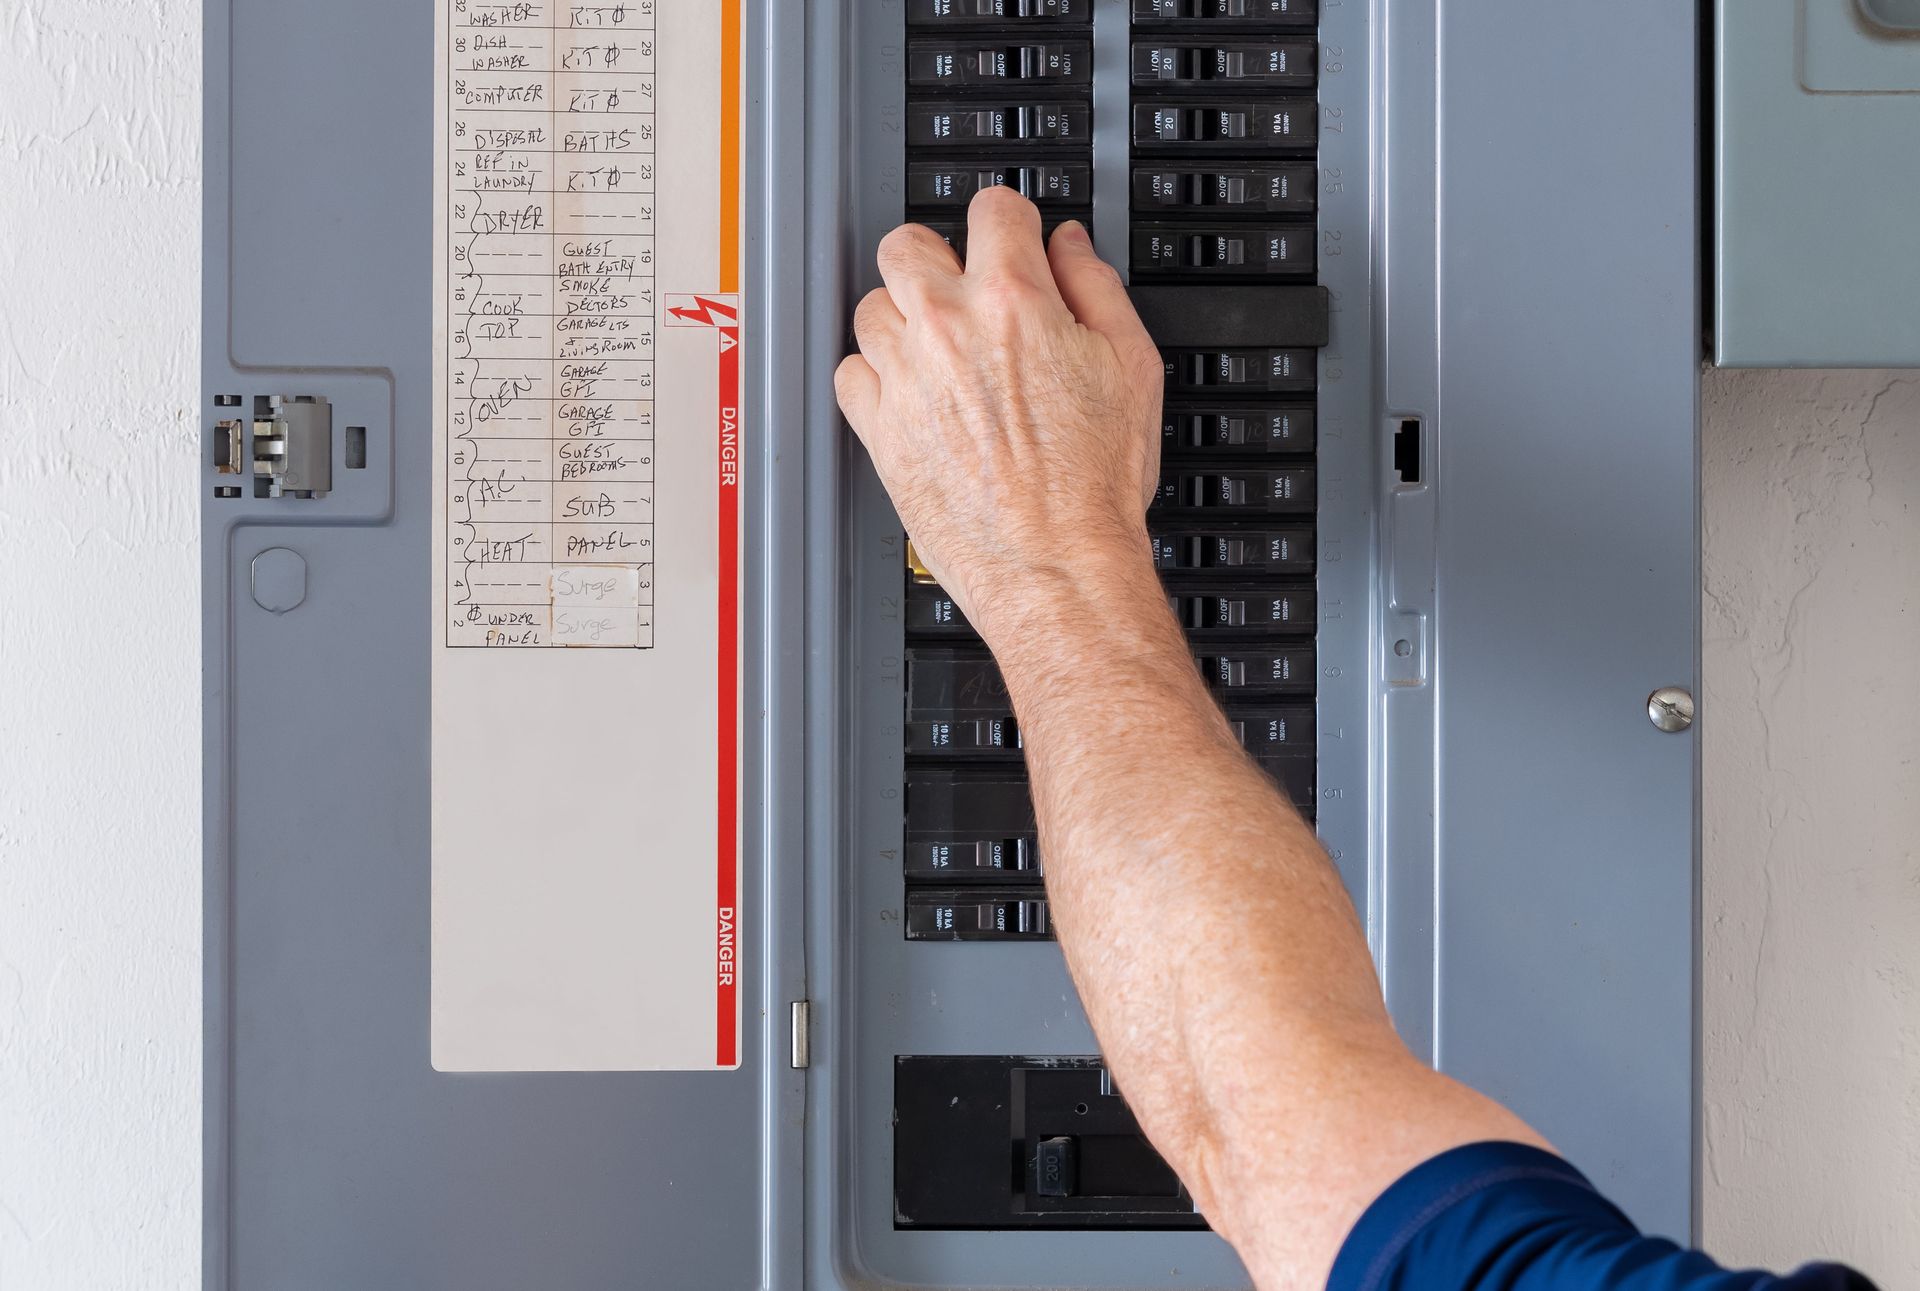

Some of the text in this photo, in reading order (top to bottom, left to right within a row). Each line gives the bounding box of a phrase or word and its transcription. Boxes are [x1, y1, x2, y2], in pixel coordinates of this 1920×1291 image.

[470, 3, 539, 27] WASHER
[641, 1, 652, 15] 31
[455, 37, 466, 53] 30
[641, 41, 652, 57] 29
[472, 54, 530, 71] WASHER
[1050, 56, 1059, 68] 20
[1163, 57, 1172, 70] 20
[455, 79, 466, 95] 28
[465, 84, 543, 104] COMPUTER
[641, 83, 652, 98] 27
[455, 121, 466, 137] 26
[1048, 116, 1056, 128] 20
[1165, 117, 1174, 130] 20
[641, 124, 652, 140] 25
[564, 128, 631, 153] BATHS
[455, 161, 466, 177] 24
[641, 164, 652, 180] 23
[473, 172, 536, 196] LAUNDRY
[1050, 176, 1058, 189] 20
[1164, 182, 1172, 195] 20
[455, 204, 466, 220] 22
[483, 204, 544, 236] DRYER
[641, 207, 652, 221] 21
[454, 245, 466, 261] 20
[562, 239, 613, 257] GUEST
[1164, 244, 1173, 257] 20
[641, 249, 652, 264] 19
[558, 260, 591, 279] BATH
[454, 286, 466, 301] 18
[559, 277, 611, 295] SMOKE
[641, 288, 652, 303] 17
[482, 296, 524, 316] COOK
[479, 317, 520, 342] TOP
[556, 315, 608, 332] GARAGE
[454, 329, 466, 344] 16
[640, 331, 652, 346] 15
[560, 361, 609, 379] GARAGE
[1165, 363, 1174, 374] 15
[454, 371, 466, 385] 14
[640, 372, 652, 388] 13
[478, 374, 532, 423] OVEN
[454, 411, 466, 425] 12
[558, 403, 614, 420] GARAGE
[640, 412, 652, 426] 11
[1165, 425, 1173, 437] 15
[559, 442, 616, 459] GUEST
[721, 407, 737, 487] DANGER
[454, 450, 466, 465] 10
[640, 456, 652, 465] 9
[454, 495, 466, 503] 8
[1165, 485, 1174, 497] 15
[562, 492, 616, 518] SUB
[640, 496, 651, 504] 7
[453, 537, 465, 546] 6
[567, 530, 632, 557] PANEL
[640, 538, 651, 547] 5
[480, 532, 534, 570] HEAT
[1163, 547, 1172, 558] 15
[453, 580, 464, 588] 4
[557, 571, 618, 600] Surge
[640, 580, 650, 589] 3
[488, 612, 535, 626] UNDER
[555, 613, 617, 641] Surge
[485, 630, 541, 647] PANEL
[719, 906, 734, 987] DANGER
[1046, 1155, 1059, 1181] 200
